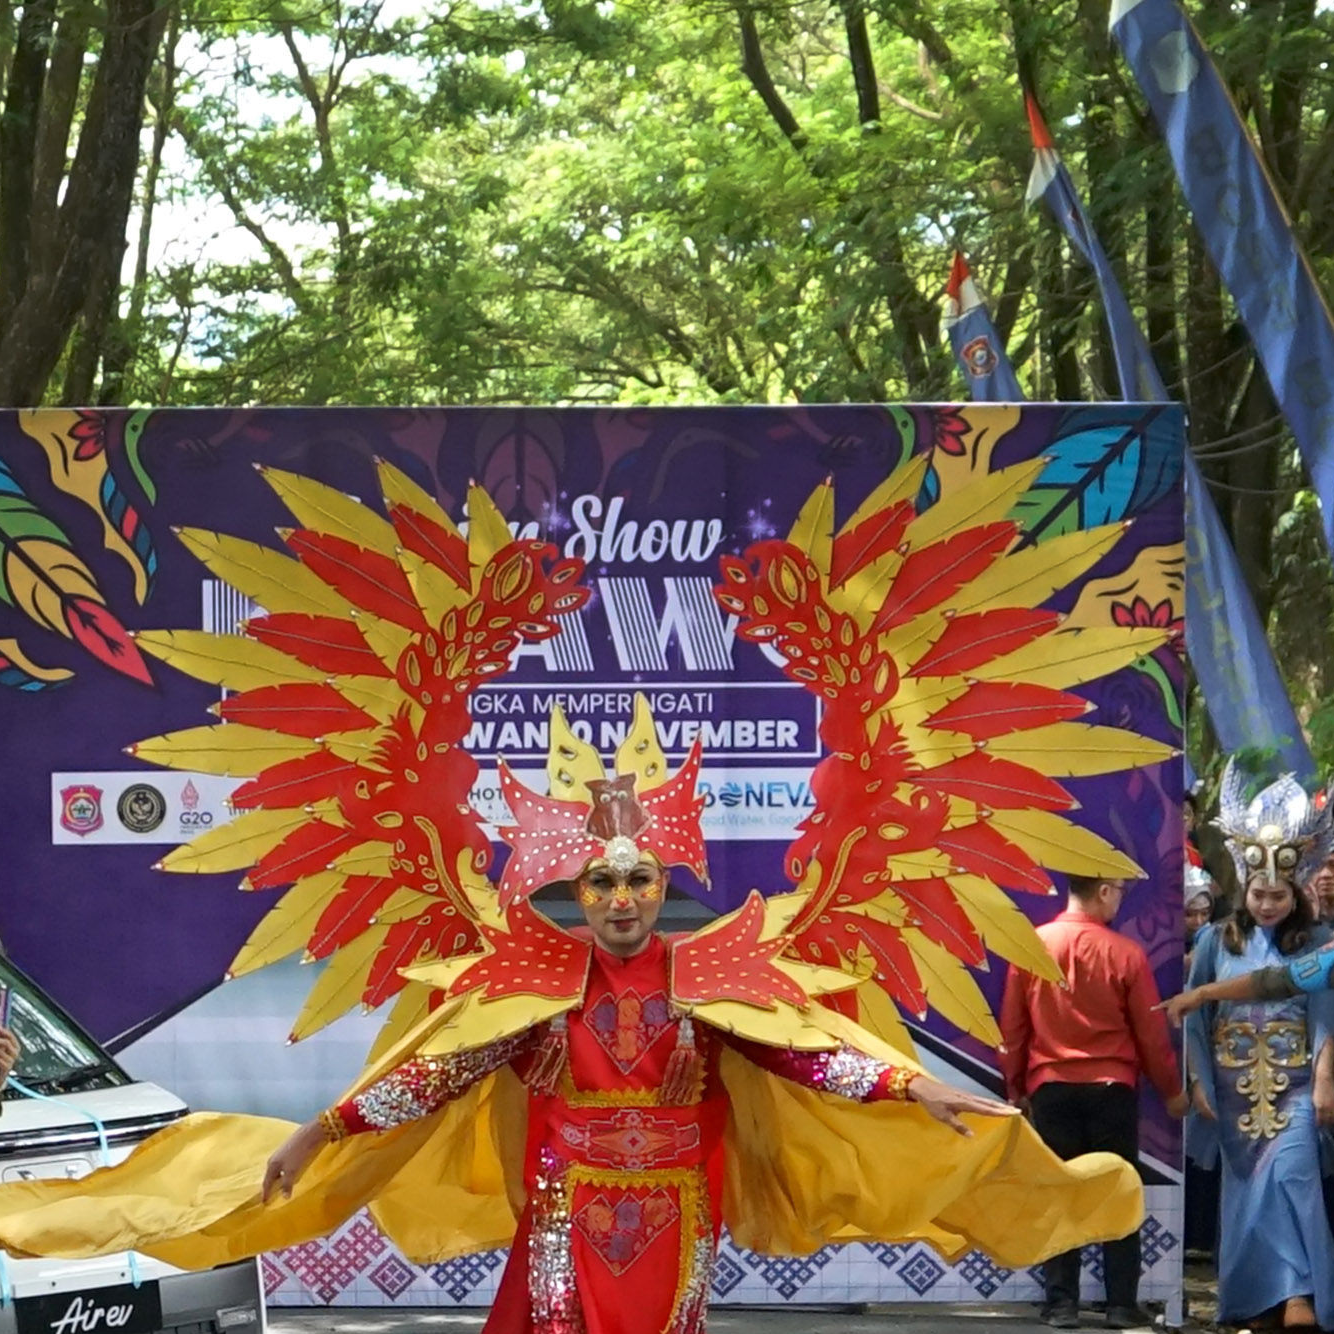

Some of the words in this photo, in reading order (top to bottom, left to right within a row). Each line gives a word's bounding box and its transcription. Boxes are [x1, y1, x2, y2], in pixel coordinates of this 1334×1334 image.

[564, 494, 726, 564] Show
[467, 693, 525, 714] GKA
[534, 692, 713, 715] MEMPERGATI
[462, 720, 548, 749] WAN
[571, 719, 593, 747] 0
[600, 719, 800, 749] NVEMBER
[470, 787, 502, 801] HOT
[179, 811, 213, 825] G20
